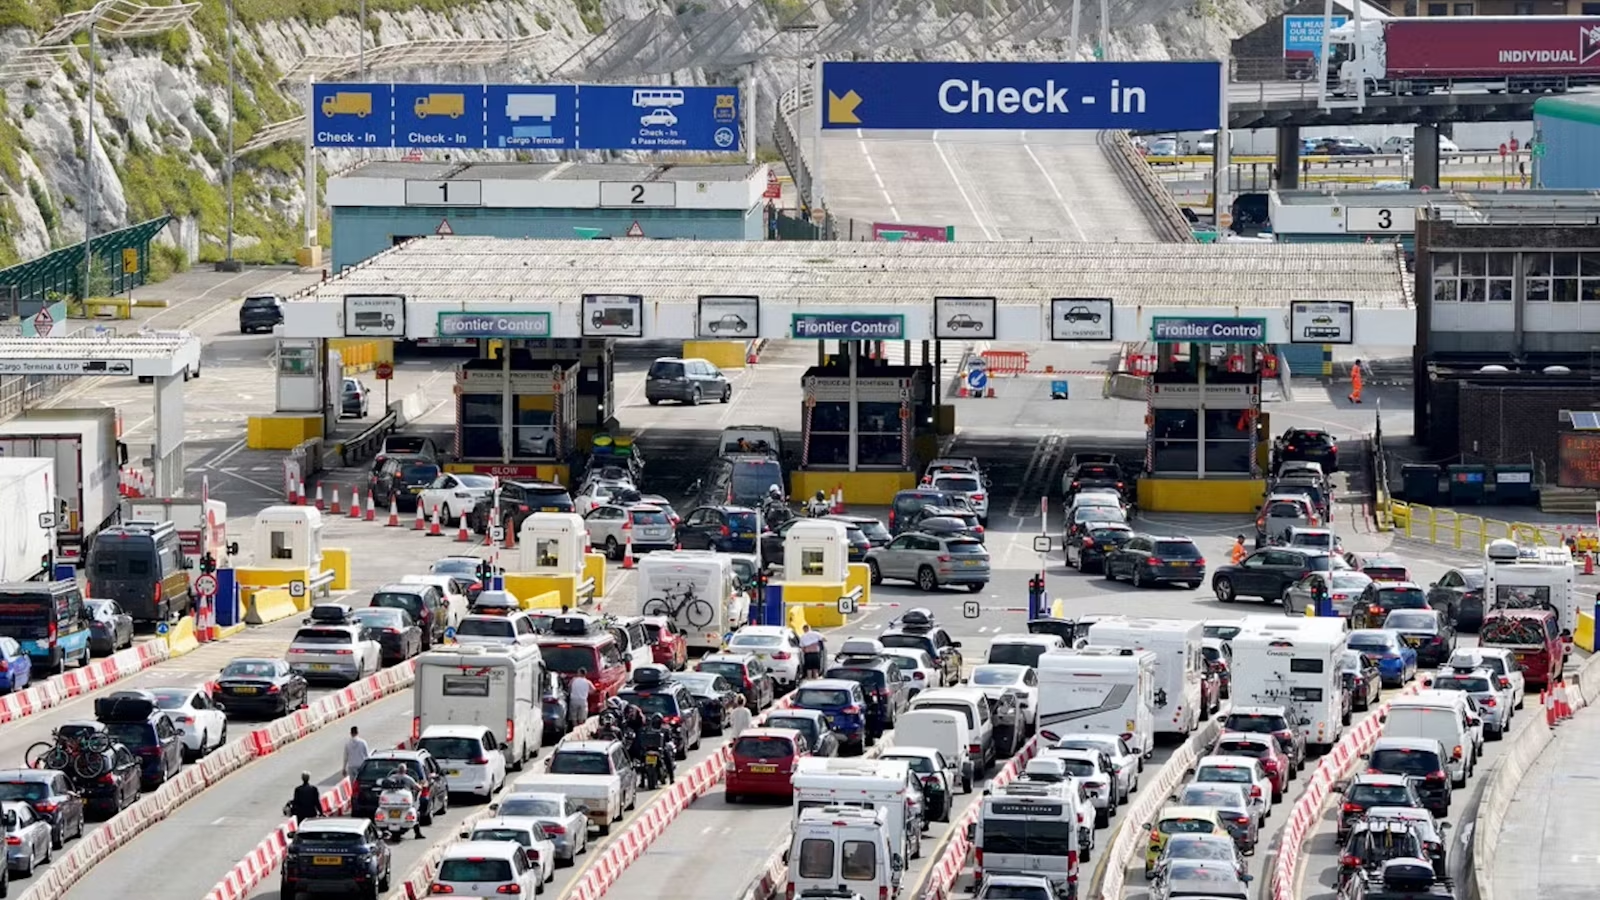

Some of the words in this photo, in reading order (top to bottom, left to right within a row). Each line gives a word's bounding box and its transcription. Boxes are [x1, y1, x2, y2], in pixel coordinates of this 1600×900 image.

[1499, 49, 1577, 63] INDIVIDUAL
[938, 78, 1069, 114] Check
[1111, 79, 1147, 114] in
[318, 132, 354, 143] Check
[365, 132, 376, 142] In
[408, 132, 445, 143] Check
[456, 133, 467, 143] In
[640, 128, 664, 136] Check
[507, 137, 530, 146] Cargo
[531, 136, 564, 144] Terminal
[631, 137, 637, 145] &
[439, 182, 448, 202] 1
[631, 184, 645, 204] 2
[1378, 208, 1392, 229] 3
[443, 318, 494, 331] Frontier
[497, 318, 546, 331] Control
[796, 320, 848, 333] Frontier
[851, 320, 900, 333] Control
[1157, 323, 1210, 336] Frontier
[1212, 323, 1262, 337] Control
[901, 389, 907, 397] 4
[491, 466, 519, 475] SLOW
[293, 584, 301, 592] C
[968, 606, 975, 614] H
